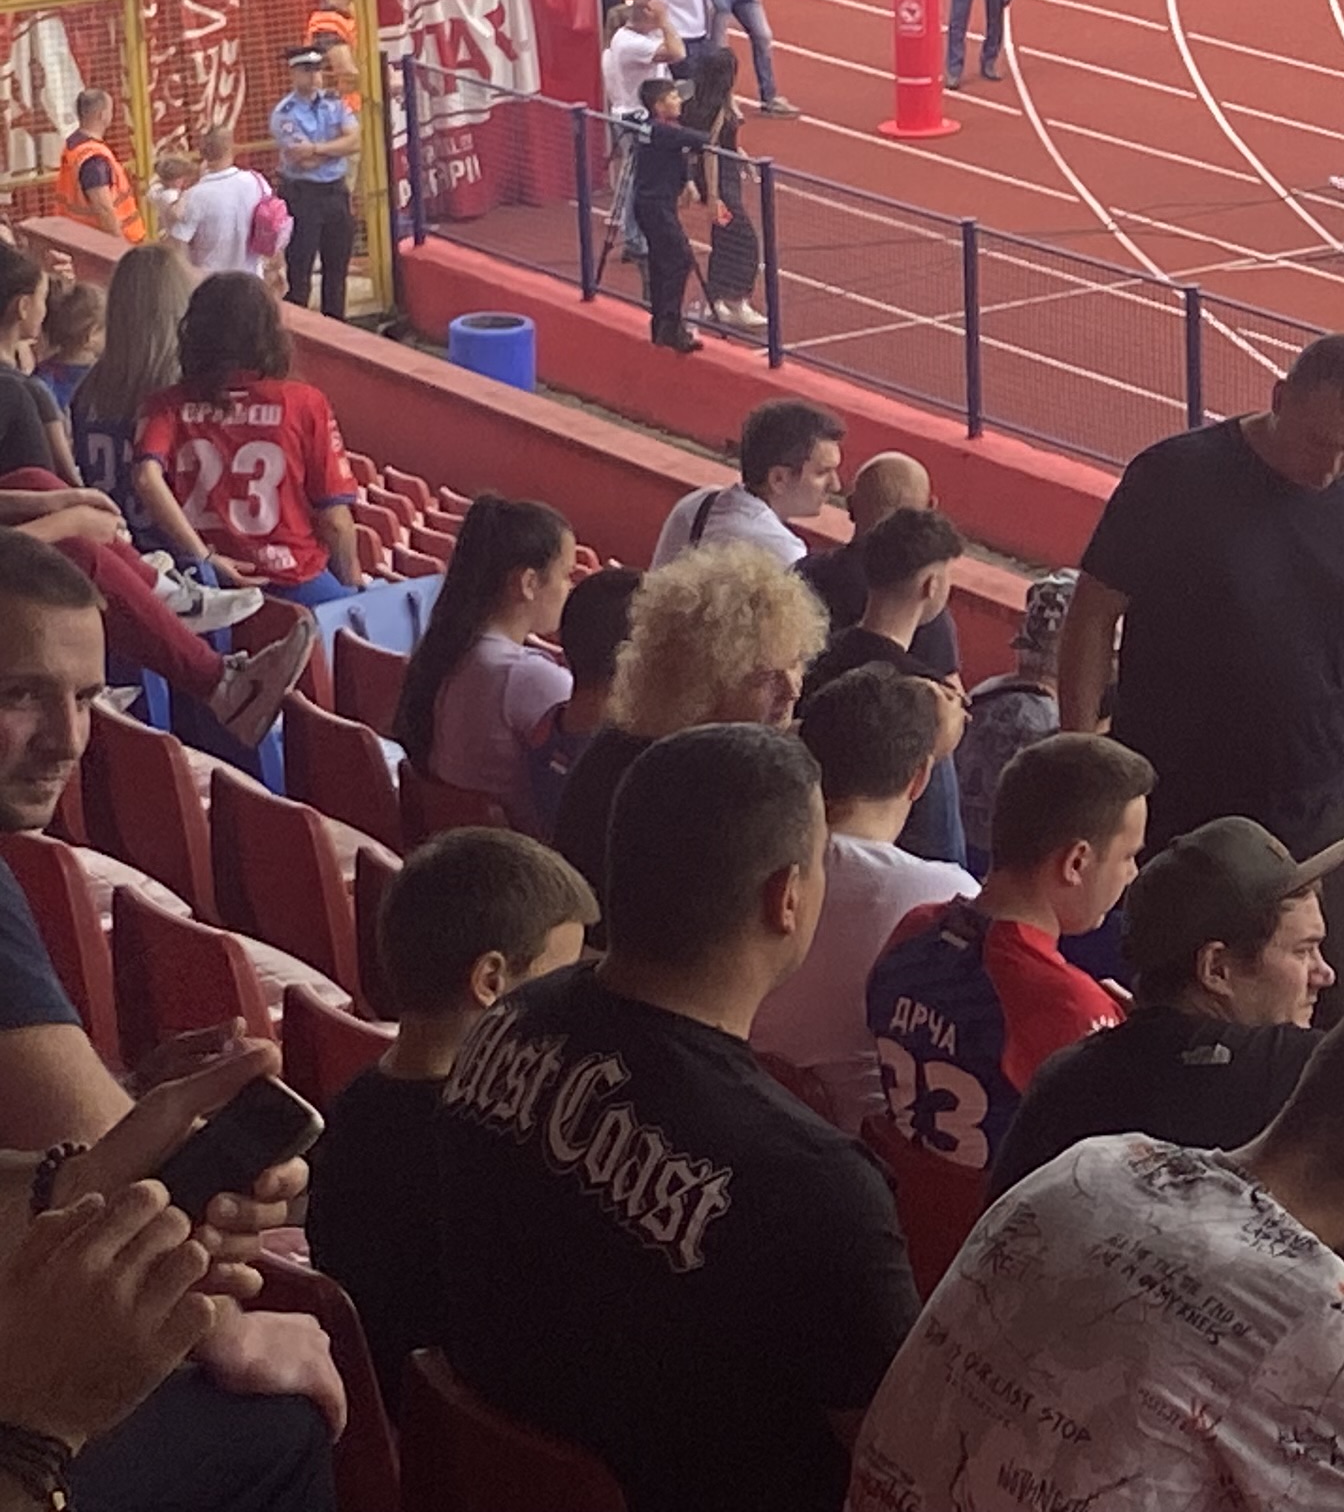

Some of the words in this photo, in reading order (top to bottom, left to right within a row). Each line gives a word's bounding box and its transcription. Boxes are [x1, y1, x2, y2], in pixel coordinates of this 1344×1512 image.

[174, 439, 286, 536] 23
[888, 996, 956, 1056] ДРЧА
[441, 996, 570, 1144] West
[542, 1050, 734, 1273] Coast
[1039, 1407, 1092, 1444] STOP
